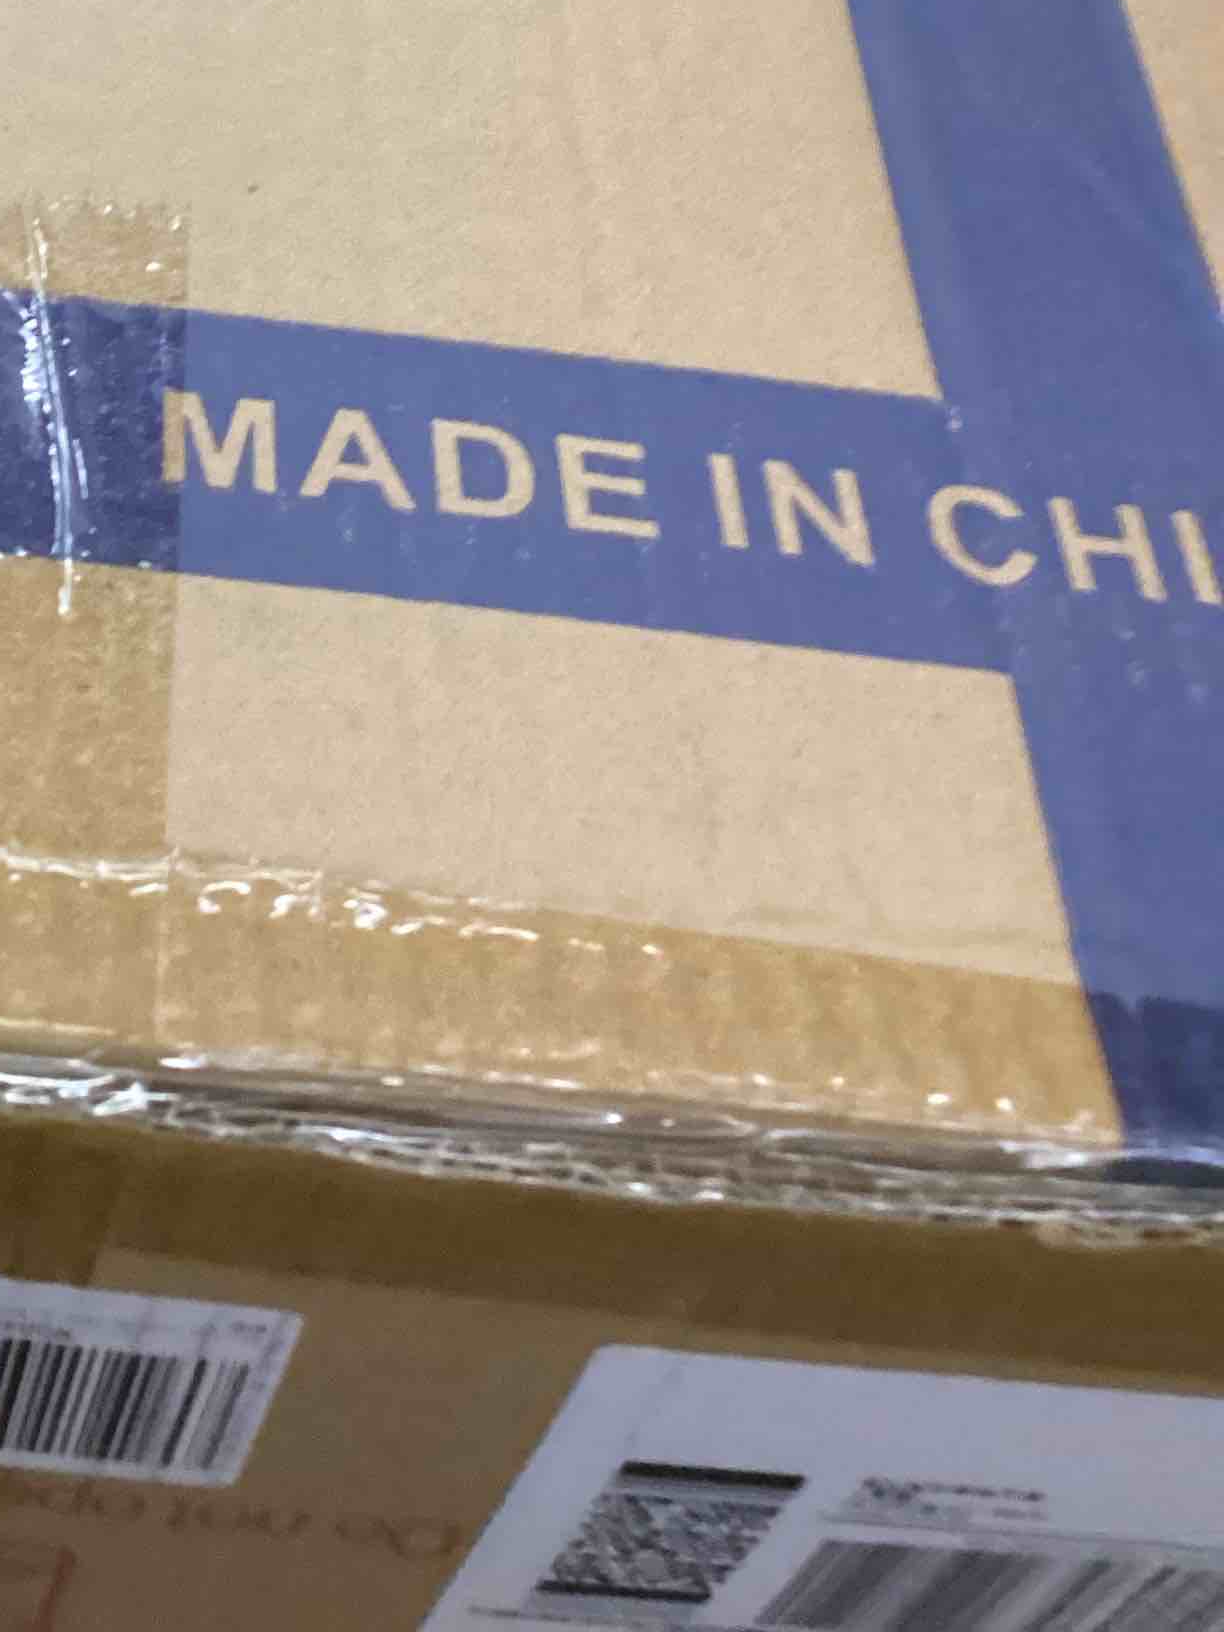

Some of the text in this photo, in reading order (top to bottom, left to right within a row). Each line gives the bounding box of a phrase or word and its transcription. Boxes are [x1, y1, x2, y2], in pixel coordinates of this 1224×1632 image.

[162, 388, 1224, 606] MADE IN CHI
